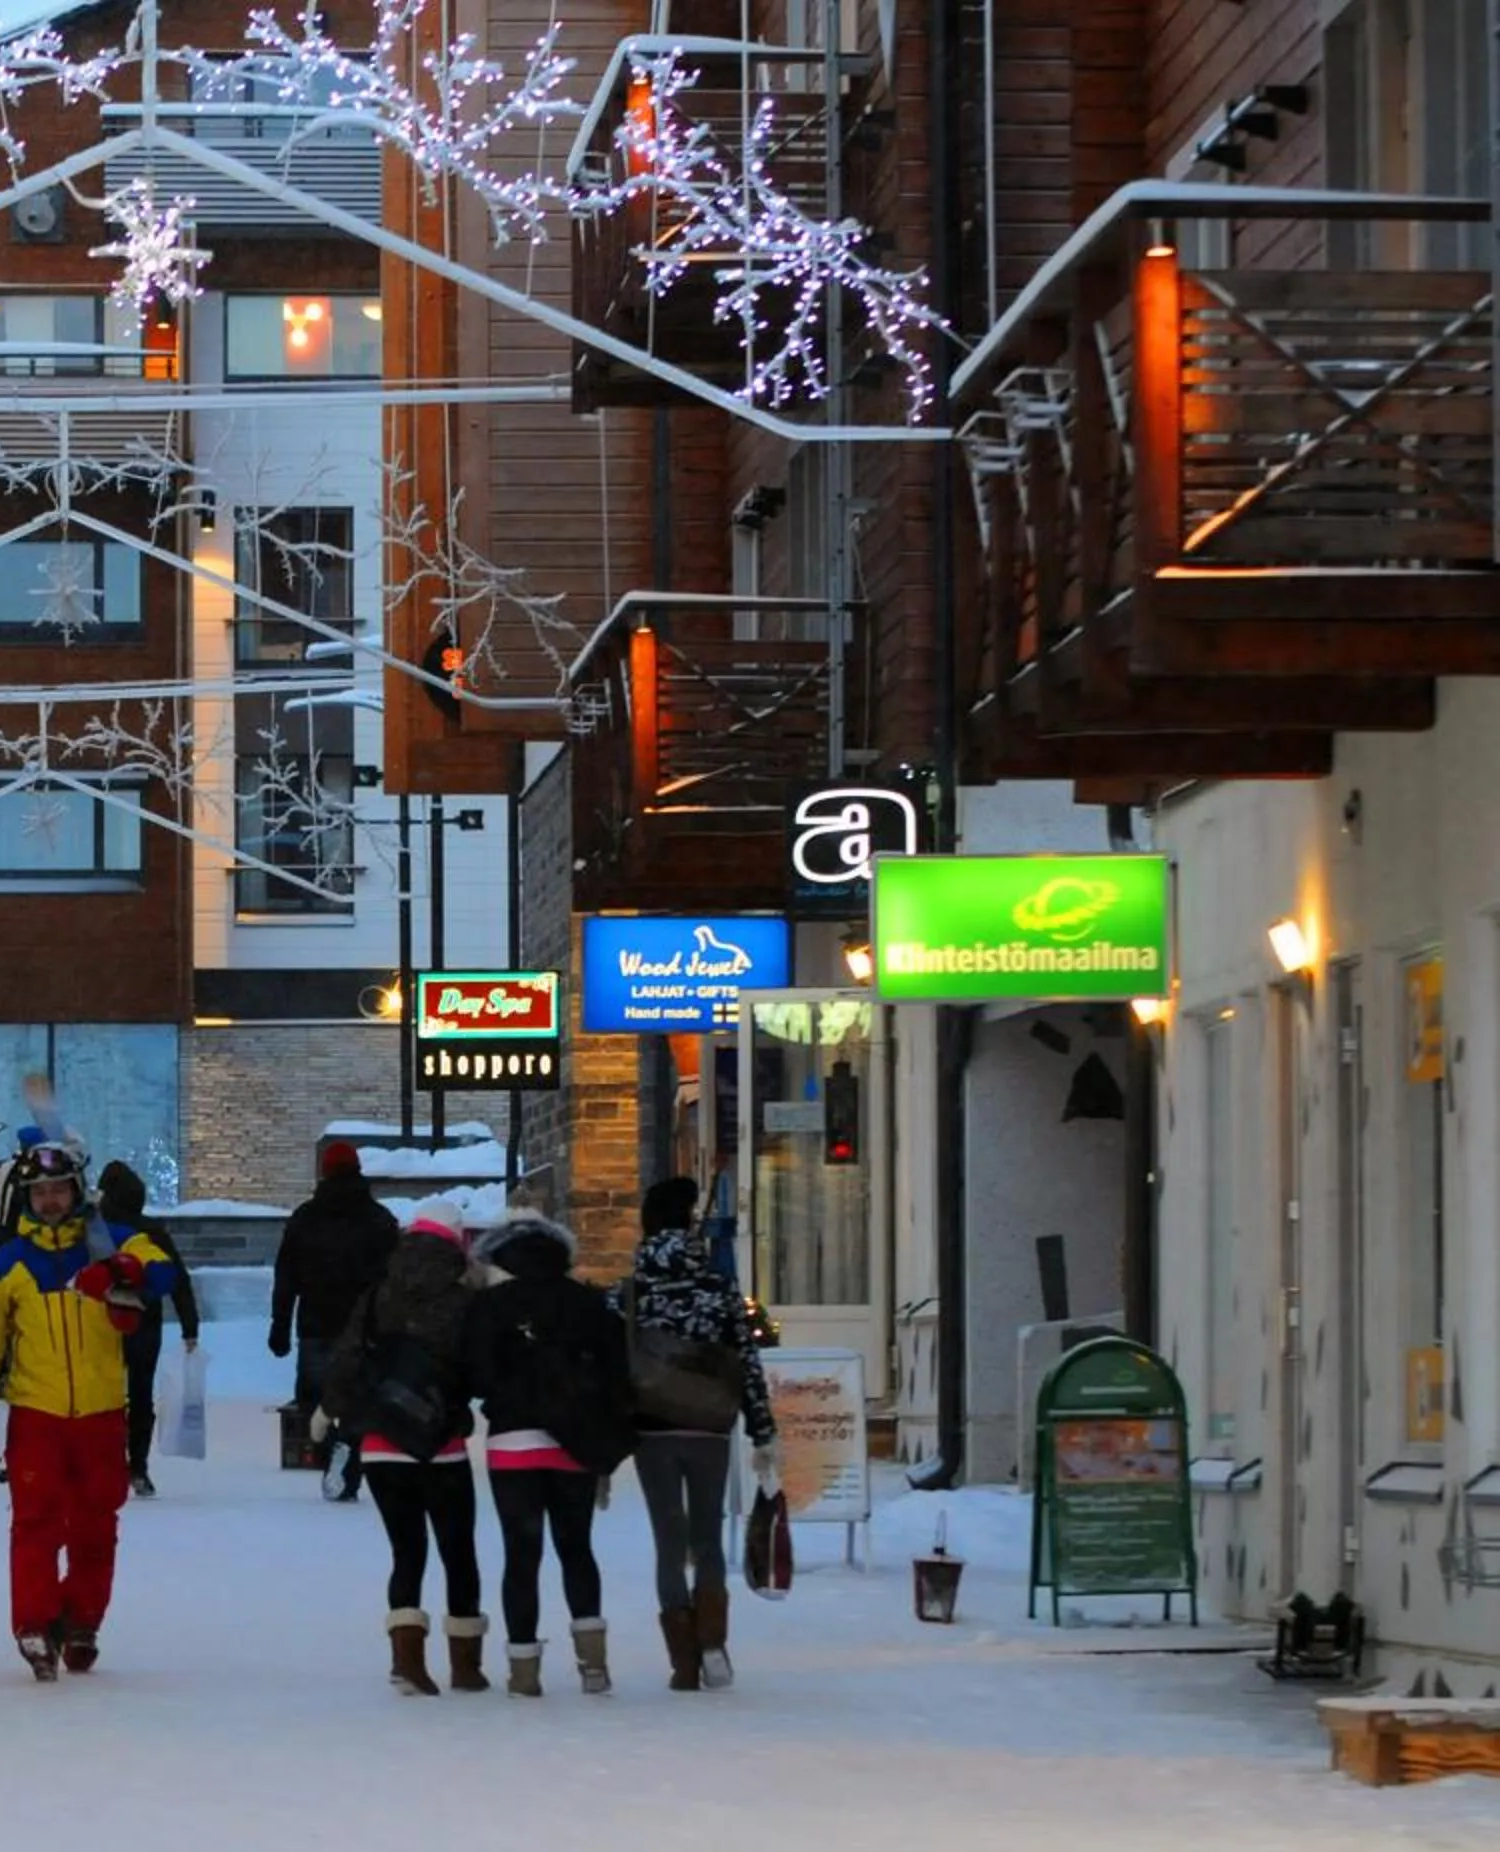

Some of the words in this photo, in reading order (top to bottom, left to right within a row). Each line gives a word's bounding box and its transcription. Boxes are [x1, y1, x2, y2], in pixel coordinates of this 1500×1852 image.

[618, 949, 682, 977] Wood
[684, 950, 749, 978] Jewel
[884, 941, 1158, 974] Kiinteistömaailma
[437, 987, 486, 1019] Day
[485, 987, 533, 1018] Spa
[624, 1005, 661, 1020] Hand
[663, 1005, 701, 1020] made
[423, 1048, 553, 1079] shopporo
